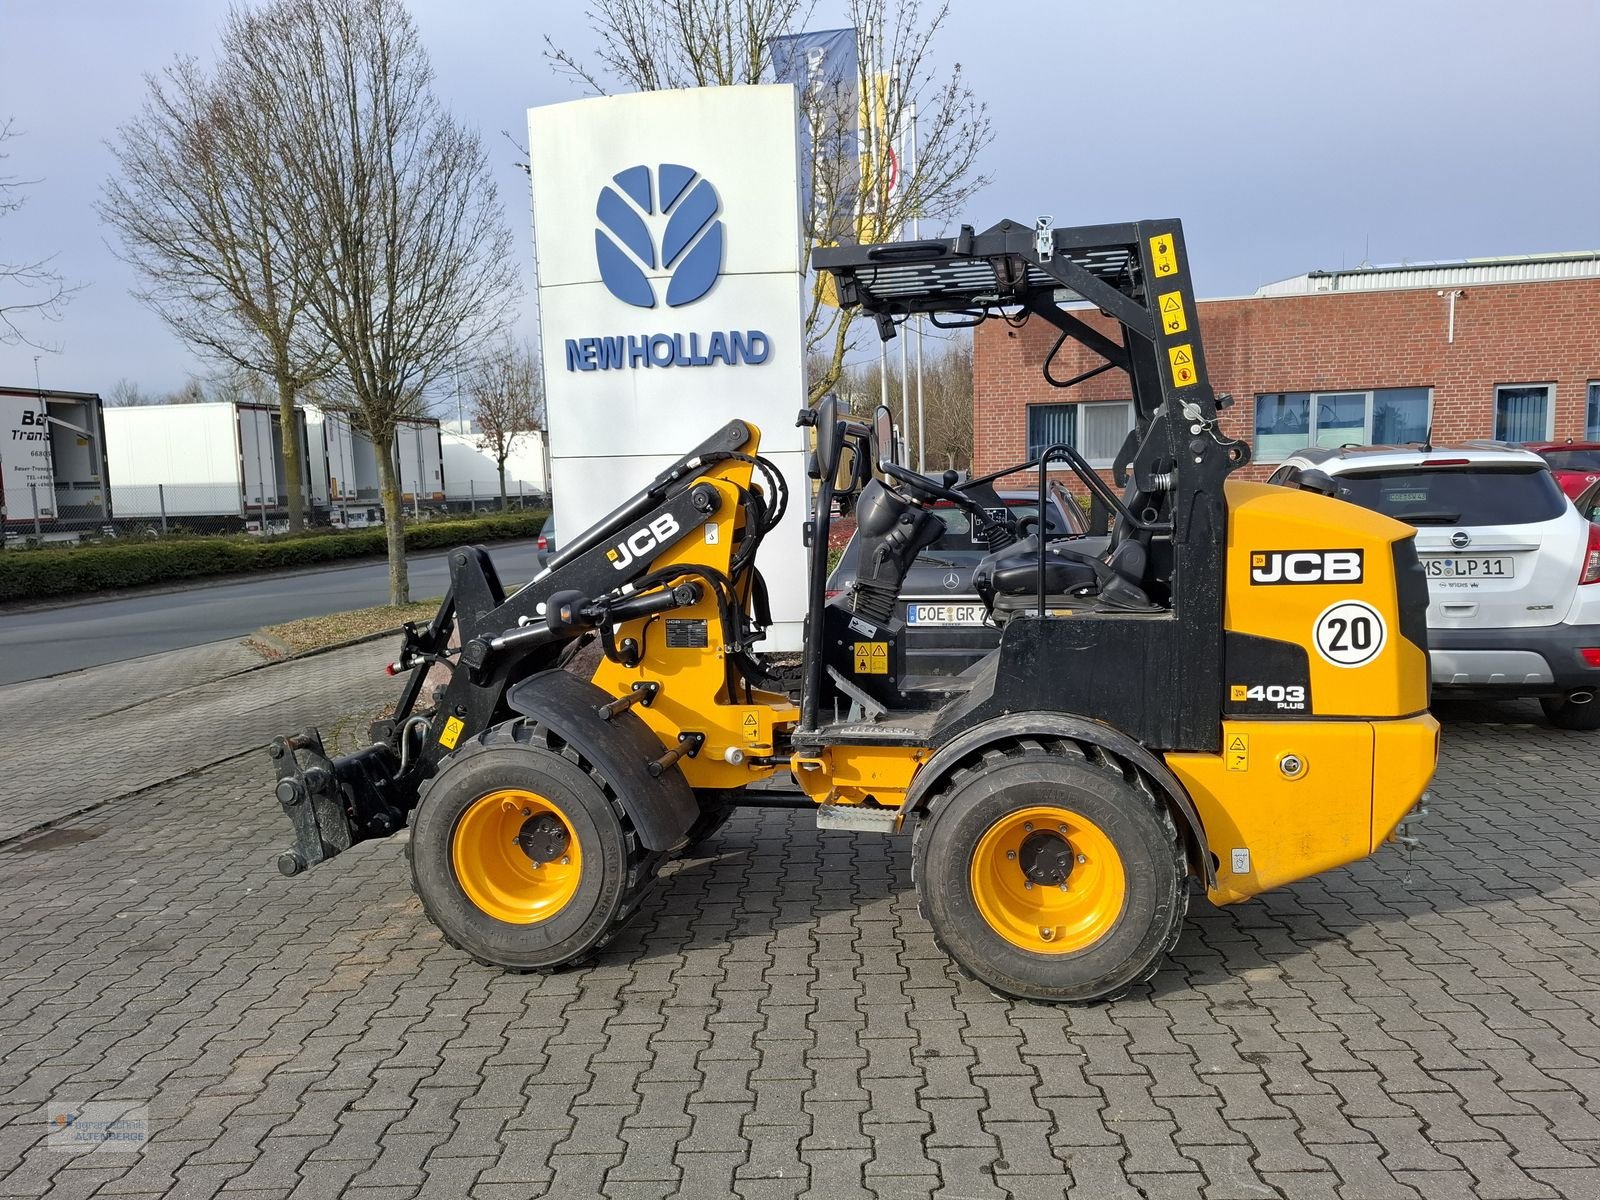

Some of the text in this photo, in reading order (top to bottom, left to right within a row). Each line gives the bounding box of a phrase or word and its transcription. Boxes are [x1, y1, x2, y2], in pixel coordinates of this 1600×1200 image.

[565, 330, 770, 372] NEW HOLLAND
[611, 512, 680, 570] JCB
[1252, 552, 1361, 583] JCB
[1455, 559, 1478, 576] LP
[1482, 559, 1505, 575] 11
[917, 607, 946, 621] COE
[956, 607, 975, 621] GR
[1327, 617, 1372, 652] 20
[1246, 685, 1305, 702] 403
[1277, 702, 1305, 710] PLUS
